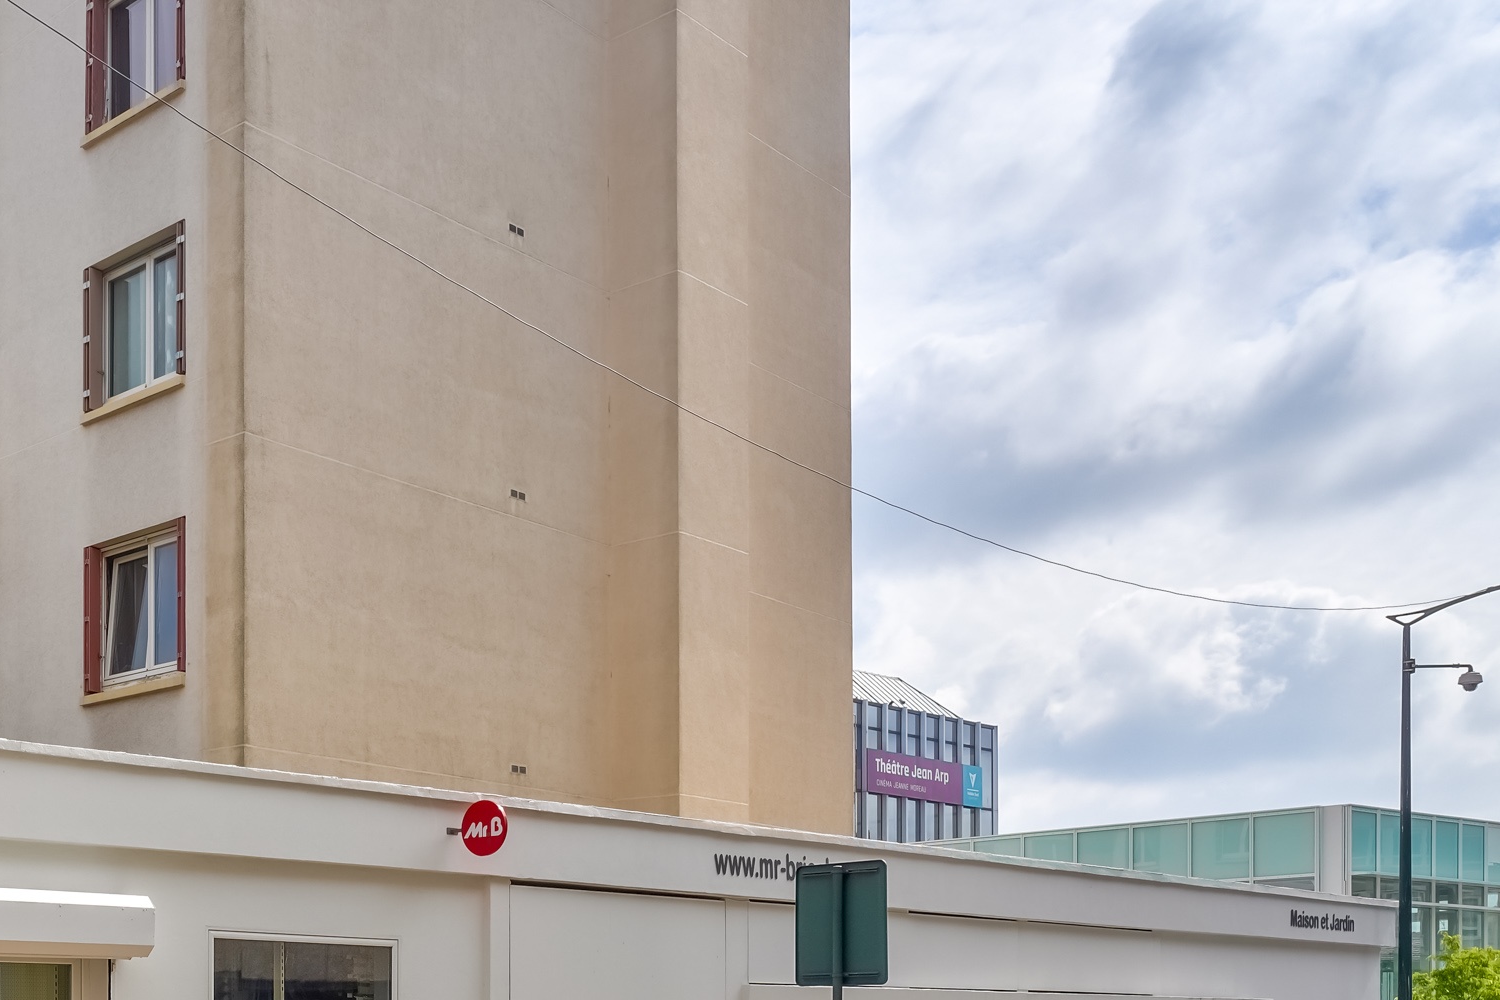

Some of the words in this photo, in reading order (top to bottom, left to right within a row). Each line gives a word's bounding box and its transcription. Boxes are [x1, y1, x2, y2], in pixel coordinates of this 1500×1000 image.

[875, 758, 909, 777] Théâtre
[911, 764, 933, 781] Jean
[934, 768, 949, 785] Arp
[1290, 908, 1320, 930] Maison
[1320, 912, 1330, 931] et
[1329, 913, 1355, 933] Jardin
